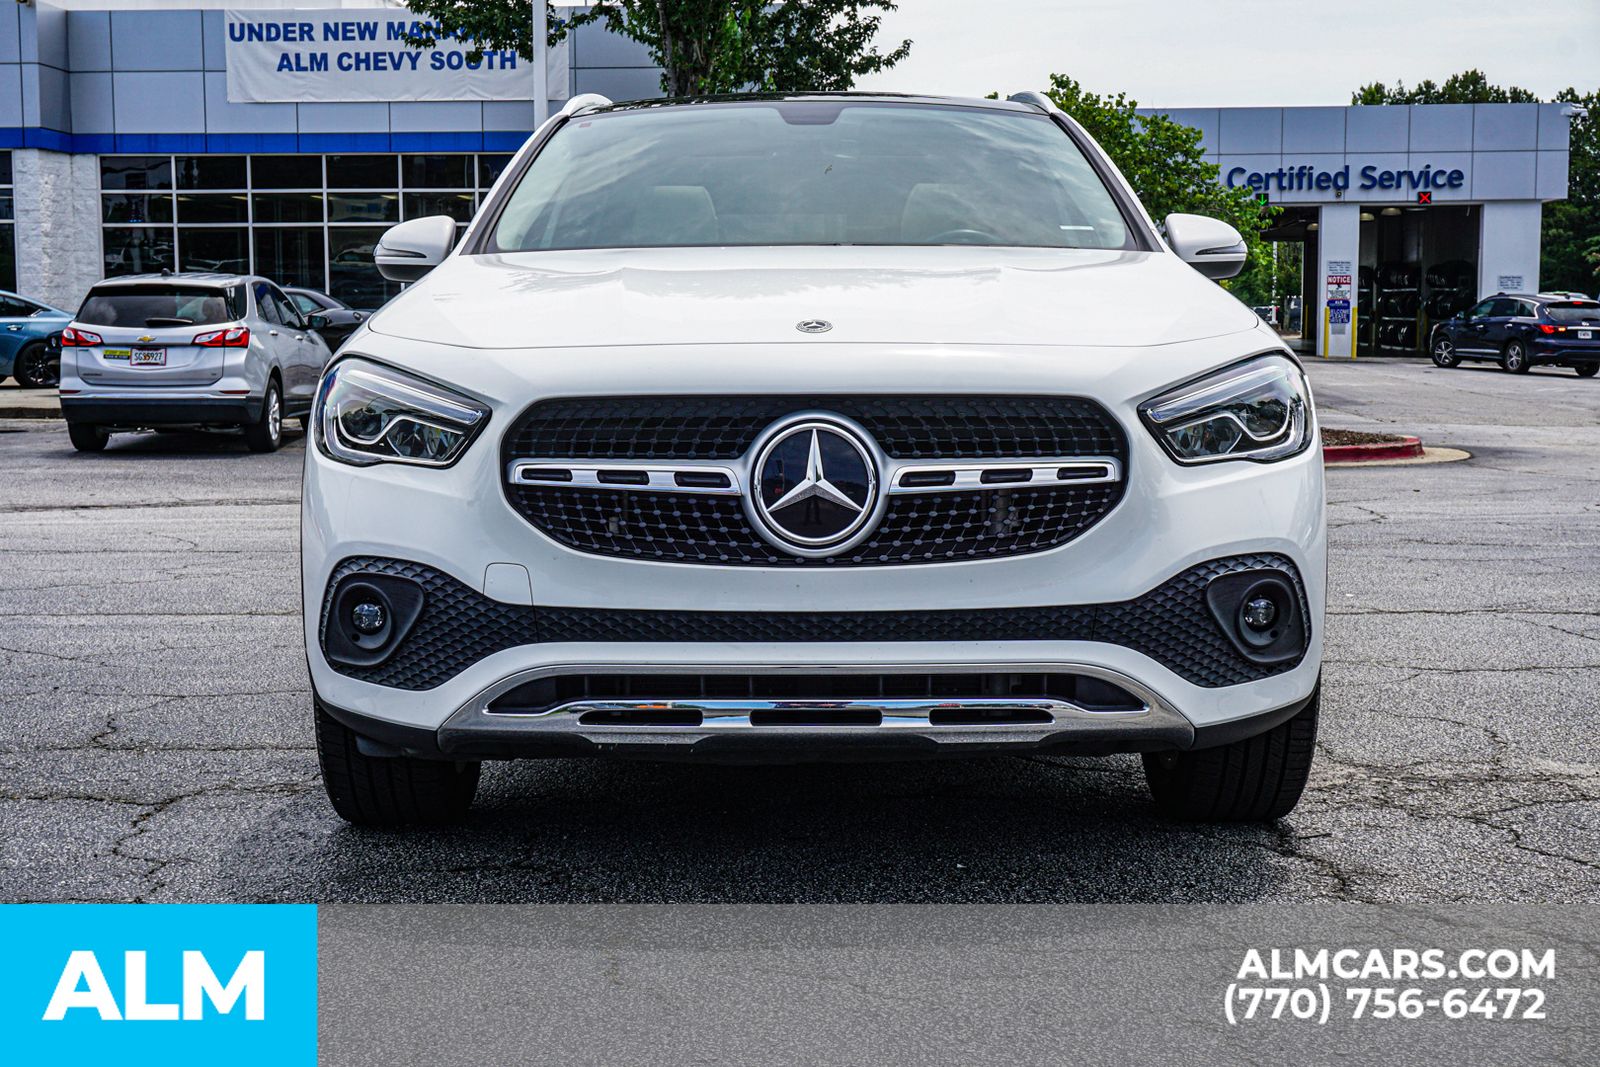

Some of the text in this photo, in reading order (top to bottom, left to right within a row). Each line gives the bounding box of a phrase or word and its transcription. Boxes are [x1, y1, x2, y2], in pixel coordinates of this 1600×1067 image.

[228, 22, 315, 42] UNDER
[323, 22, 379, 41] NEW
[277, 53, 329, 72] ALM
[337, 52, 422, 71] CHEVY
[1227, 164, 1465, 191] Certified Service
[1327, 276, 1351, 284] NOTICE
